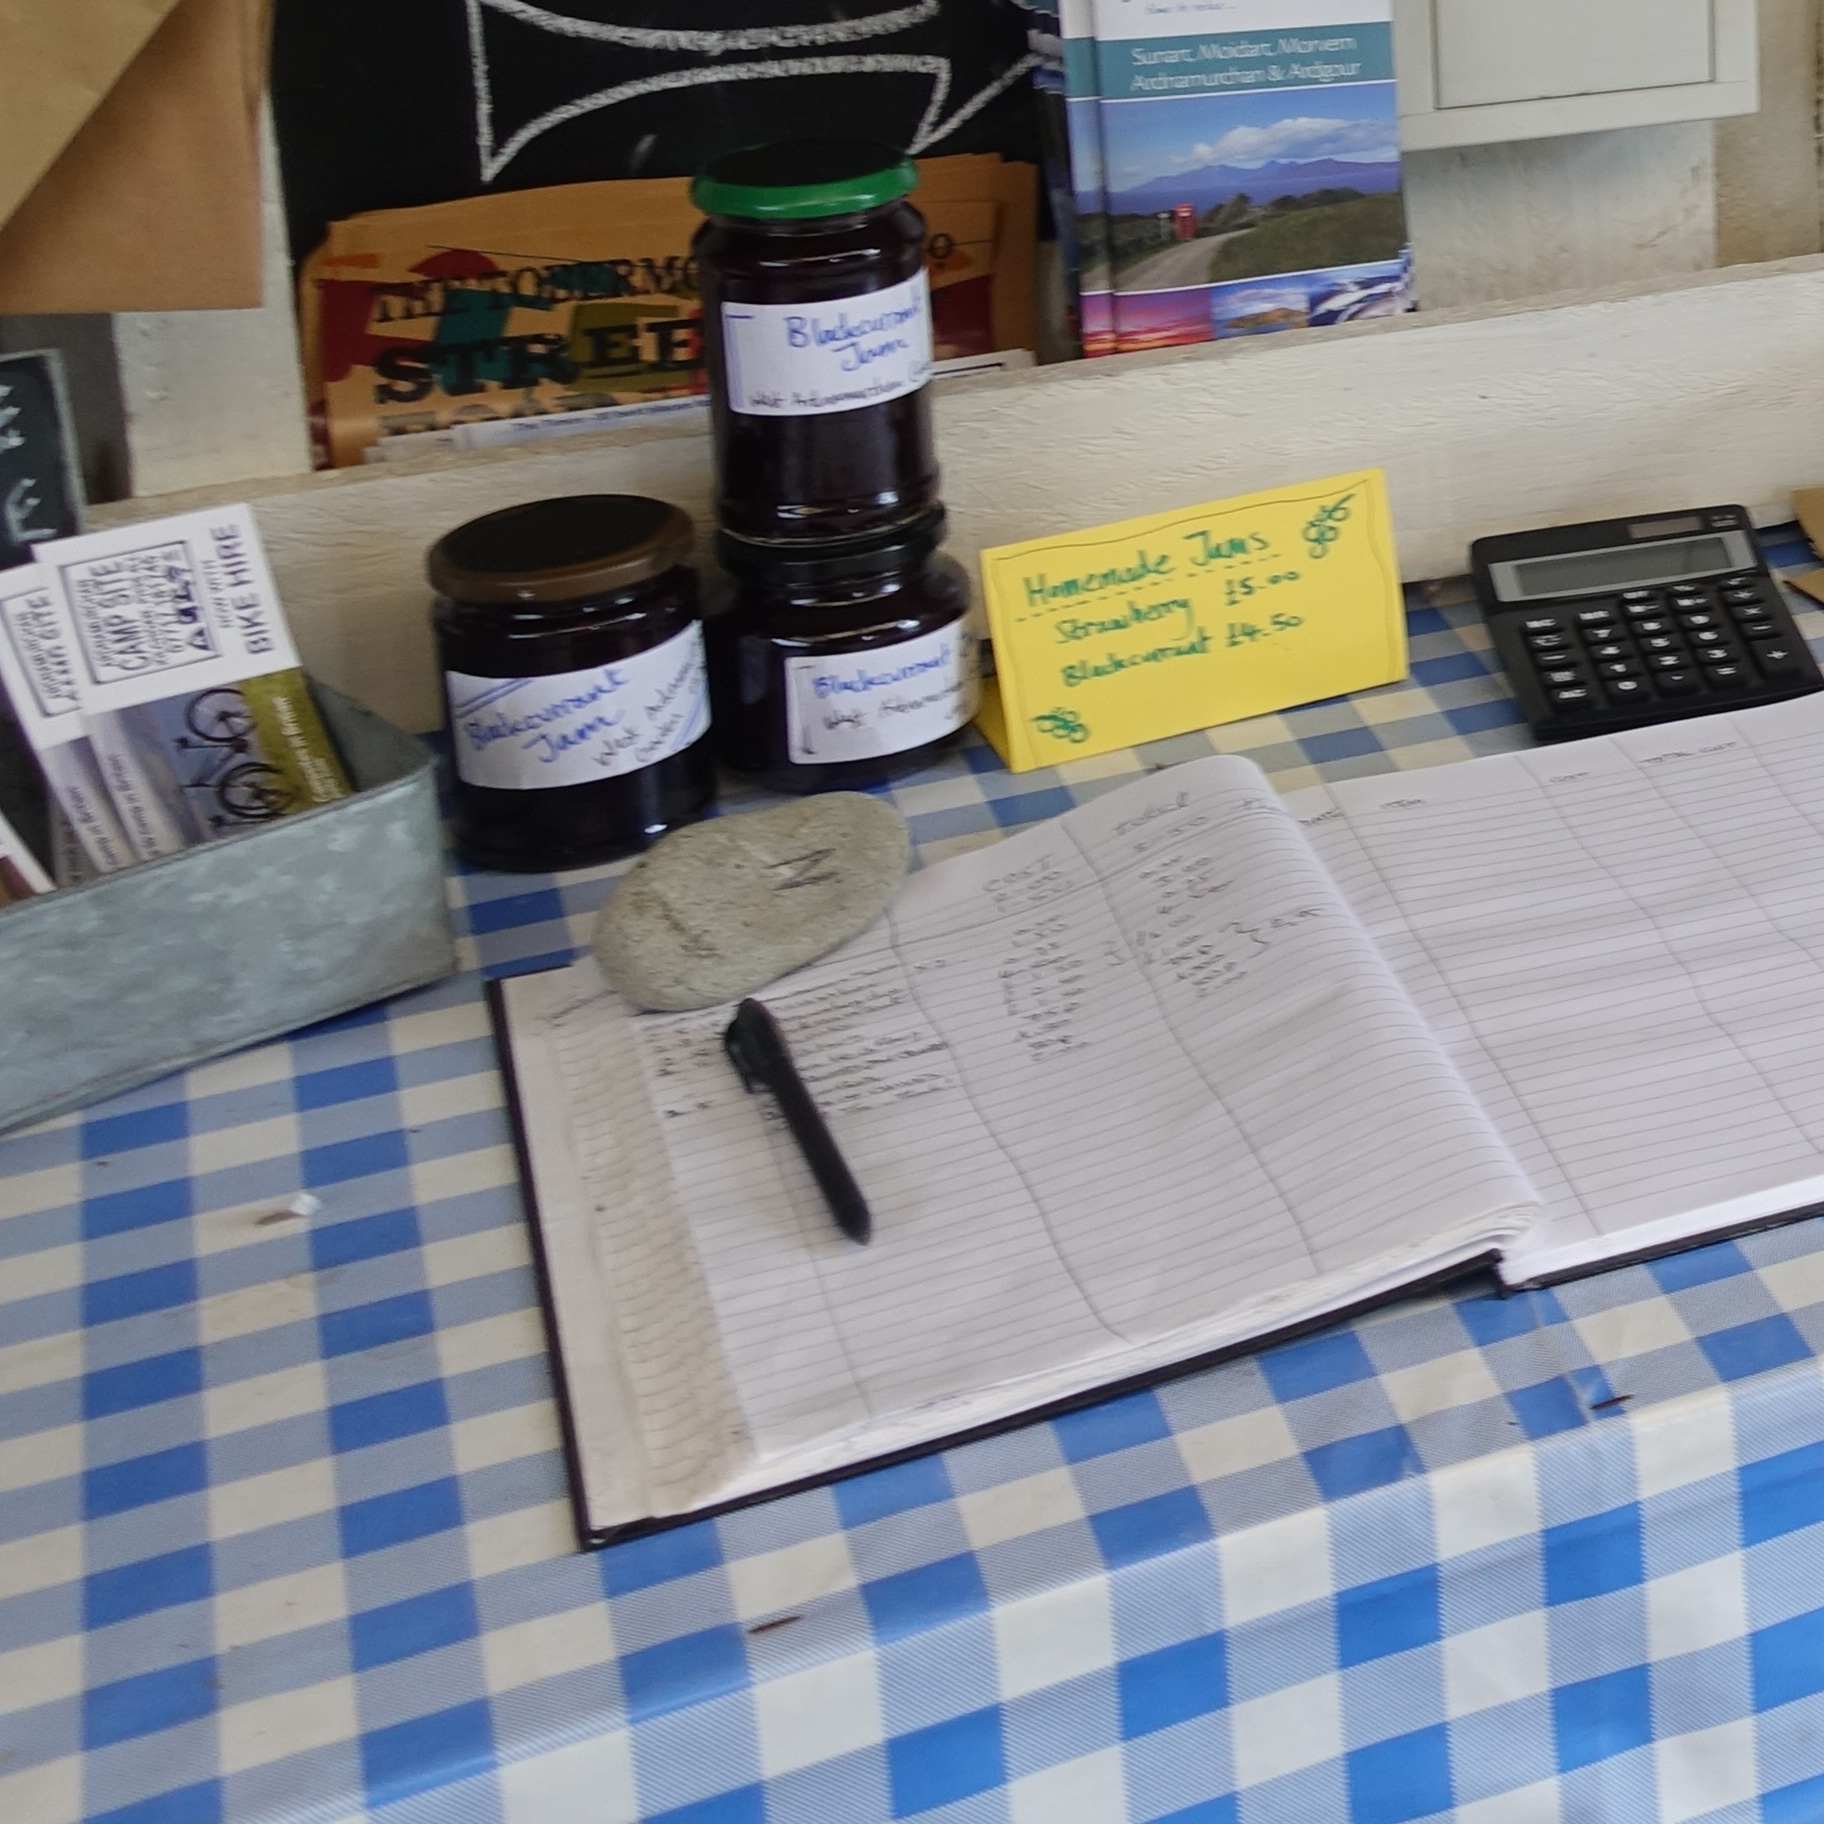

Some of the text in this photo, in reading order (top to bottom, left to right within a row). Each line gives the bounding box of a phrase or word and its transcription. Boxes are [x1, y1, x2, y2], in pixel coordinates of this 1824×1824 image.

[1278, 35, 1358, 55] Morvern
[1129, 59, 1363, 92] Ardnamurchan & Ardgour
[474, 254, 703, 312] TOBERMO
[374, 317, 704, 406] STREE
[831, 336, 910, 373] Jam
[210, 521, 275, 657] BIKE HIRE
[1023, 528, 1272, 608] Homemade Jams
[87, 558, 152, 673] CAMP SITE
[1053, 595, 1194, 646] Strawberry
[1060, 611, 1308, 690] Blackcurrant £4.50
[520, 708, 626, 764] Jam
